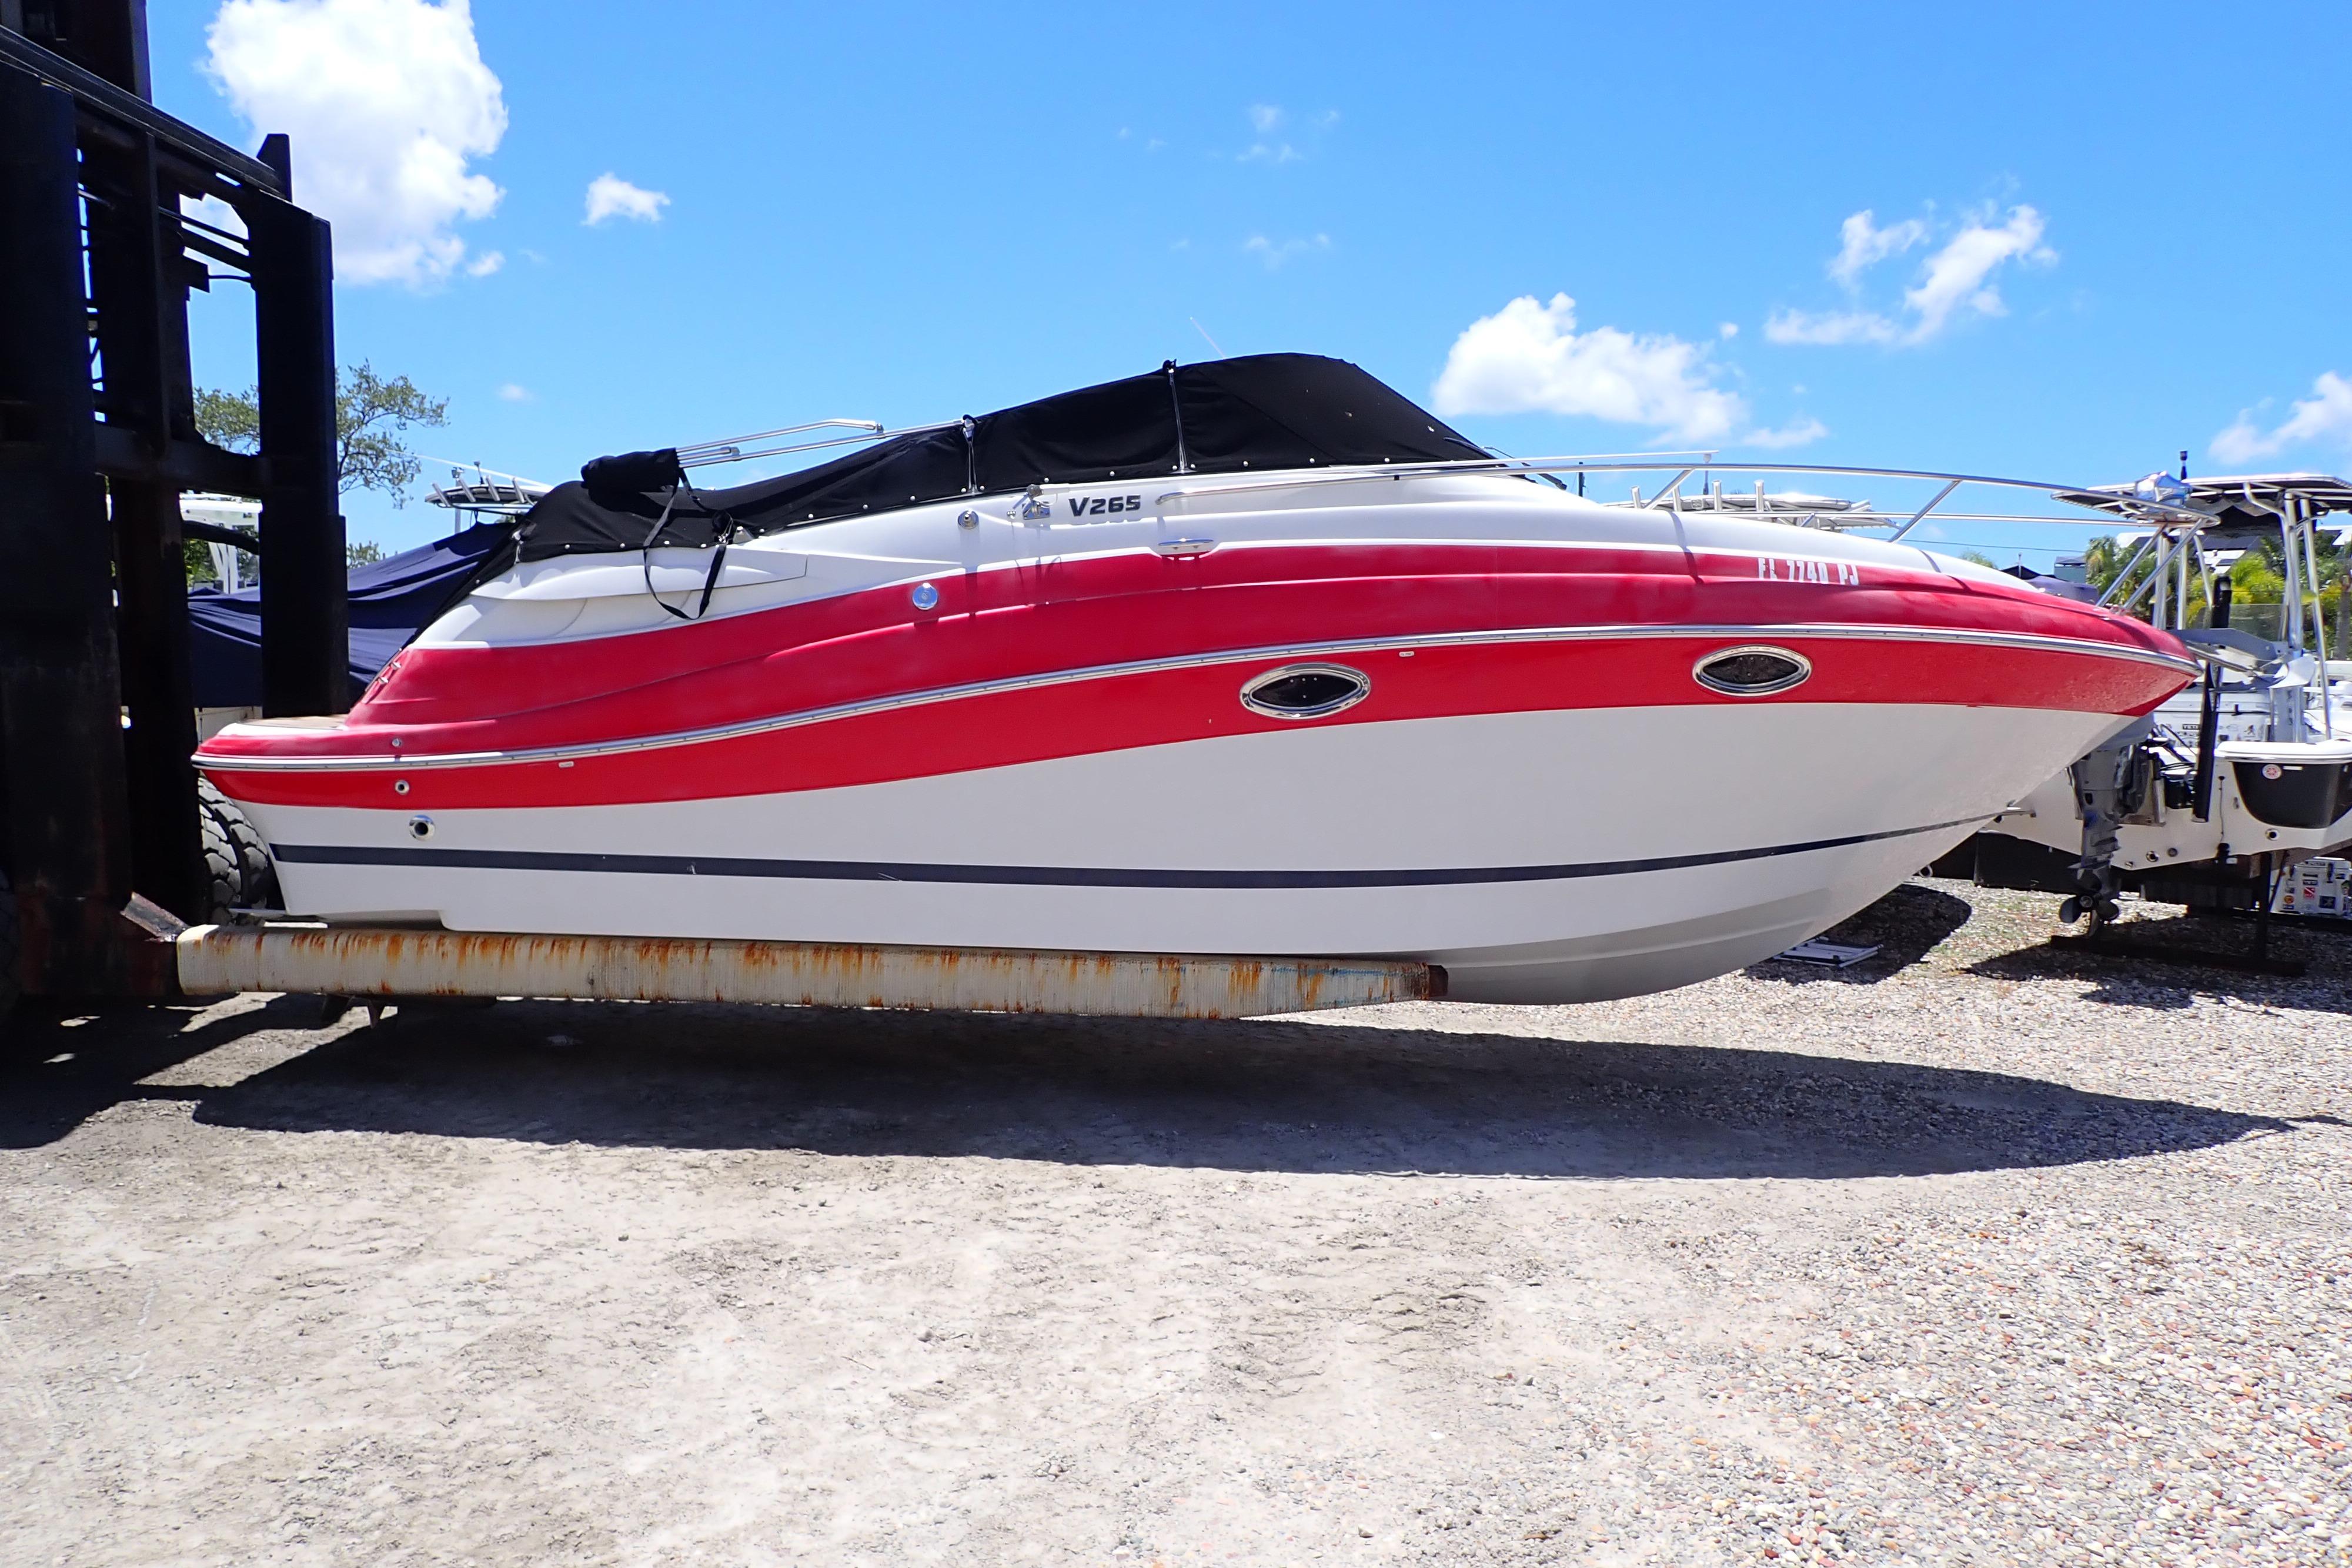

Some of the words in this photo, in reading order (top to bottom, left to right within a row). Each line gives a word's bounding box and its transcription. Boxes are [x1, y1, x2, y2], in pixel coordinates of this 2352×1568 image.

[1068, 494, 1141, 517] V265
[1758, 557, 1777, 580] FL
[1786, 560, 1829, 584] 7740
[1837, 563, 1859, 586] PJ
